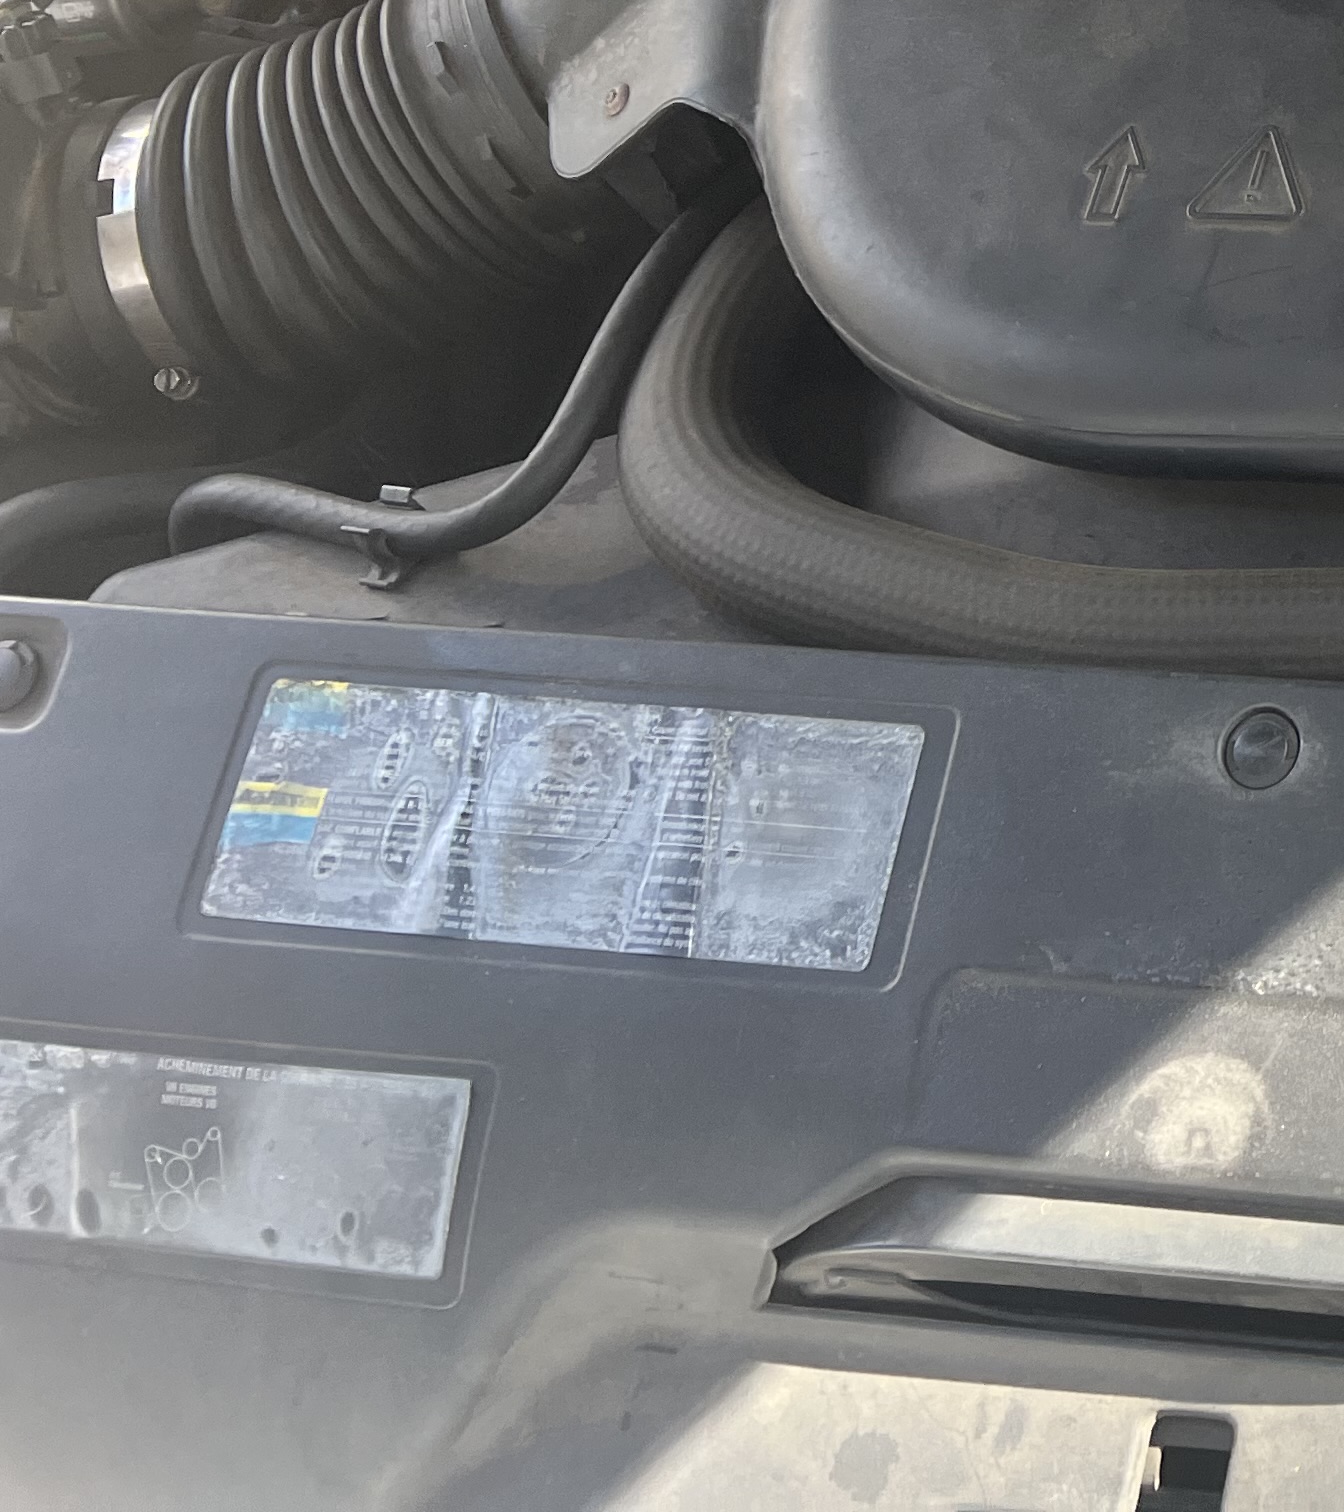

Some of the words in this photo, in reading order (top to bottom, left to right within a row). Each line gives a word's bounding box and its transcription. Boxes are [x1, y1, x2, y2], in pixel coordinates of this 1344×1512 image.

[156, 1056, 244, 1080] ACHEMINEMENT
[245, 1066, 261, 1081] DE
[262, 1069, 278, 1082] LA
